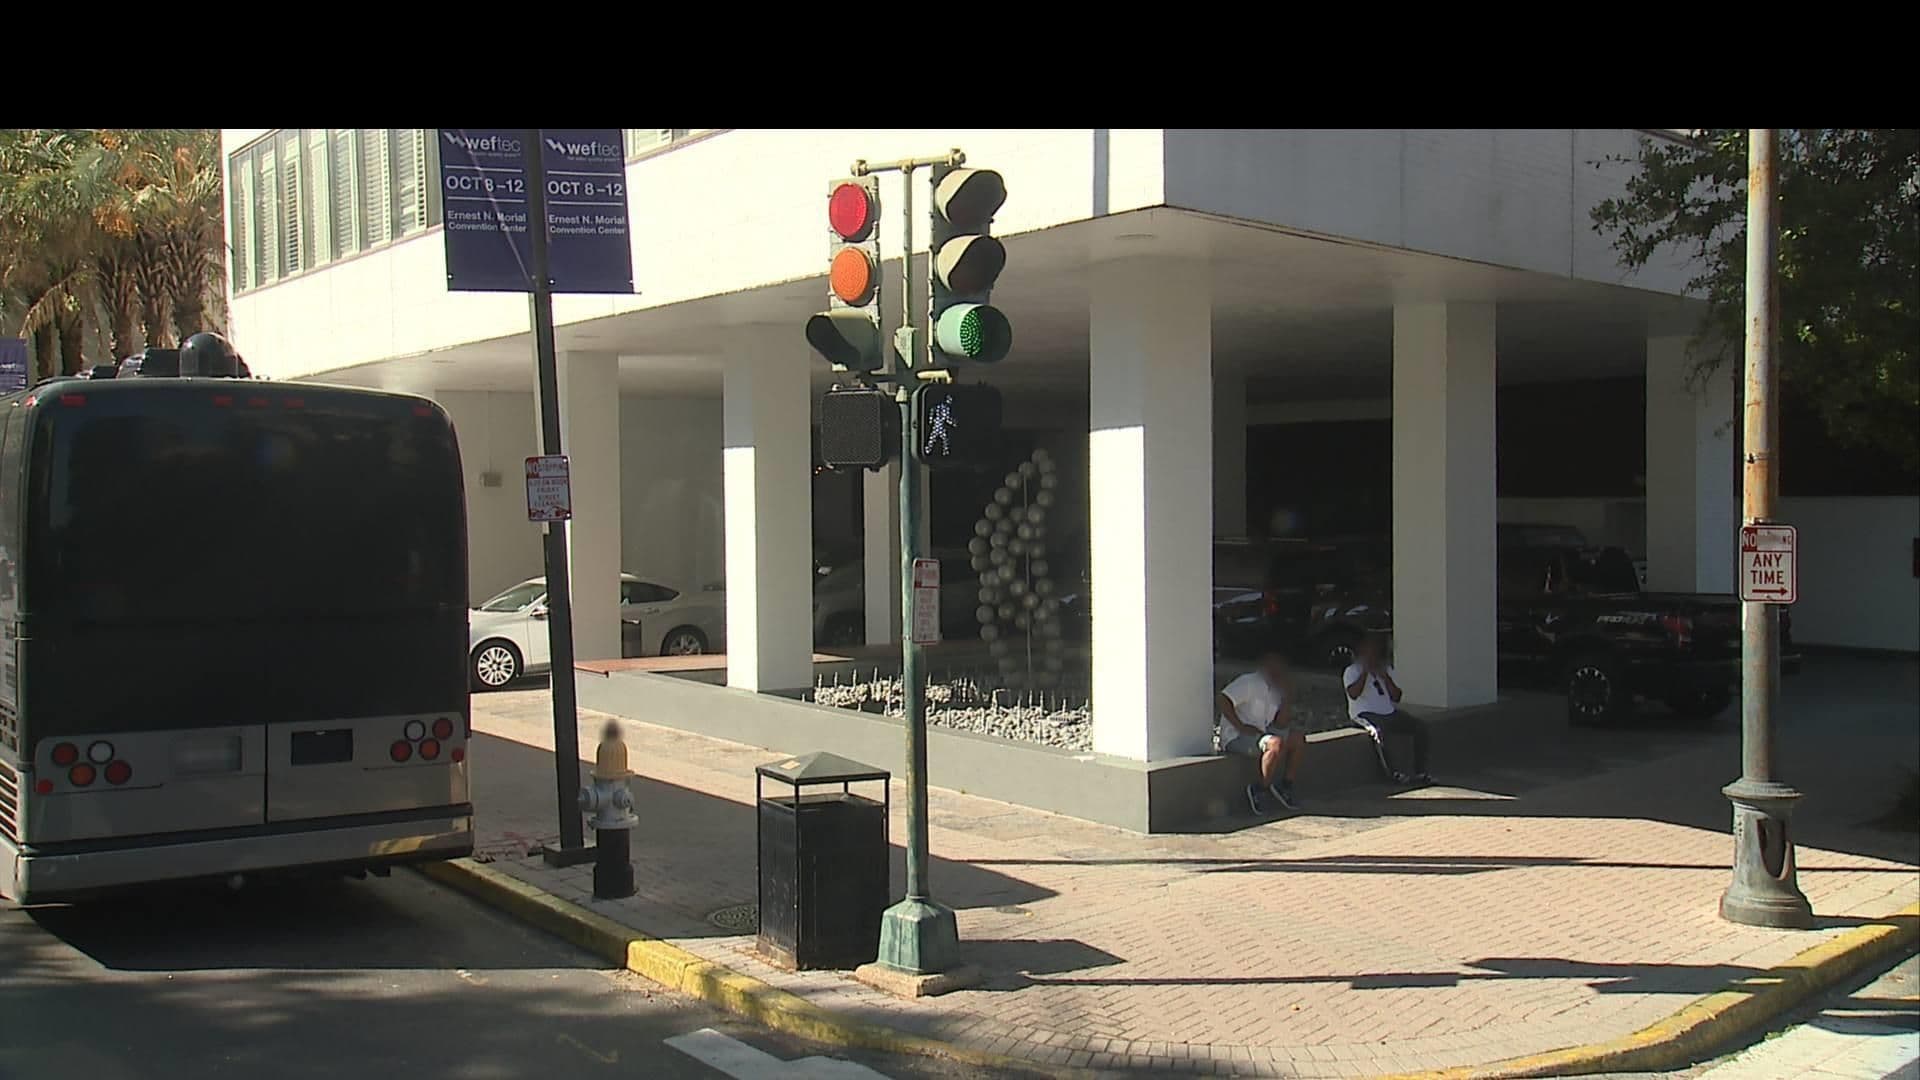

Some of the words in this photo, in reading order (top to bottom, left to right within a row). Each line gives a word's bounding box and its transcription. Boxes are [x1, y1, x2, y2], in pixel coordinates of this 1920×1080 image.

[465, 136, 521, 152] weftec
[567, 141, 620, 157] weftec
[446, 176, 482, 191] OCT
[547, 181, 580, 196] OCT
[447, 210, 482, 221] Ernest
[484, 212, 494, 221] N.
[497, 212, 526, 222] Morial
[548, 215, 580, 225] Ernest
[582, 215, 593, 225] N.
[595, 215, 625, 225] Morial
[448, 221, 498, 231] Convention
[500, 223, 527, 232] Center
[549, 226, 597, 234] Convention
[597, 226, 625, 235] Center
[1743, 531, 1756, 548] NO
[1753, 553, 1782, 568] ANY
[1750, 570, 1784, 585] TIME
